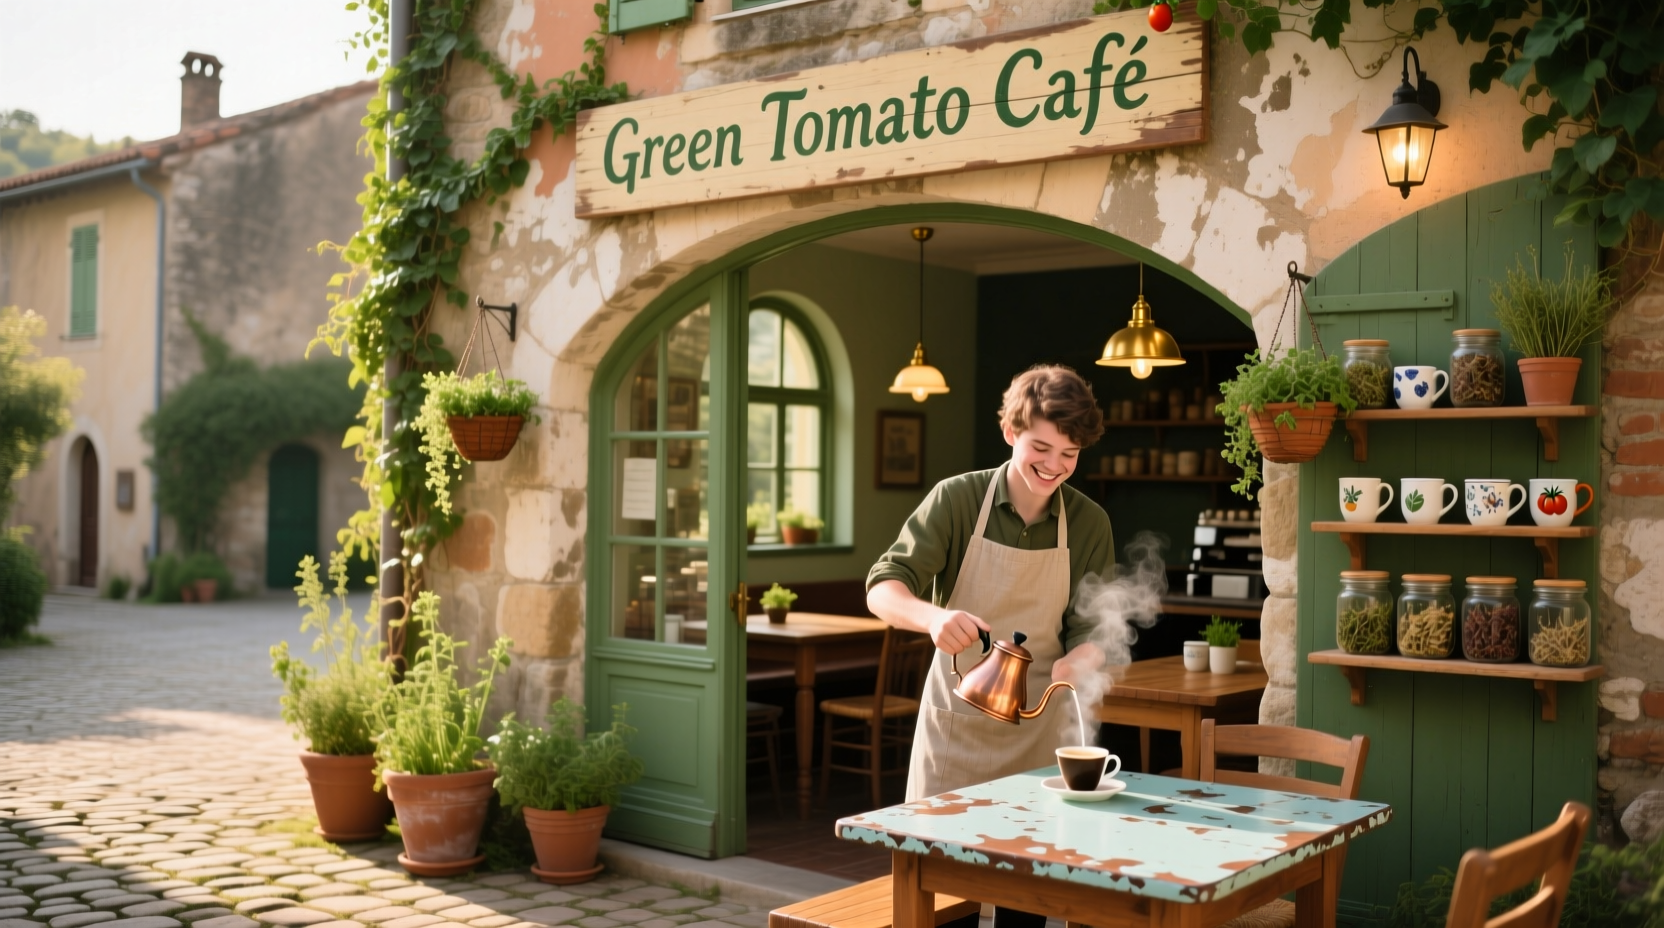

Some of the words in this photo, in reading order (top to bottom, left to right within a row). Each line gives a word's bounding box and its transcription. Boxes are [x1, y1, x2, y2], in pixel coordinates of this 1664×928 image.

[603, 117, 743, 194] Green
[761, 75, 970, 161] Tomato
[994, 31, 1150, 135] Café
